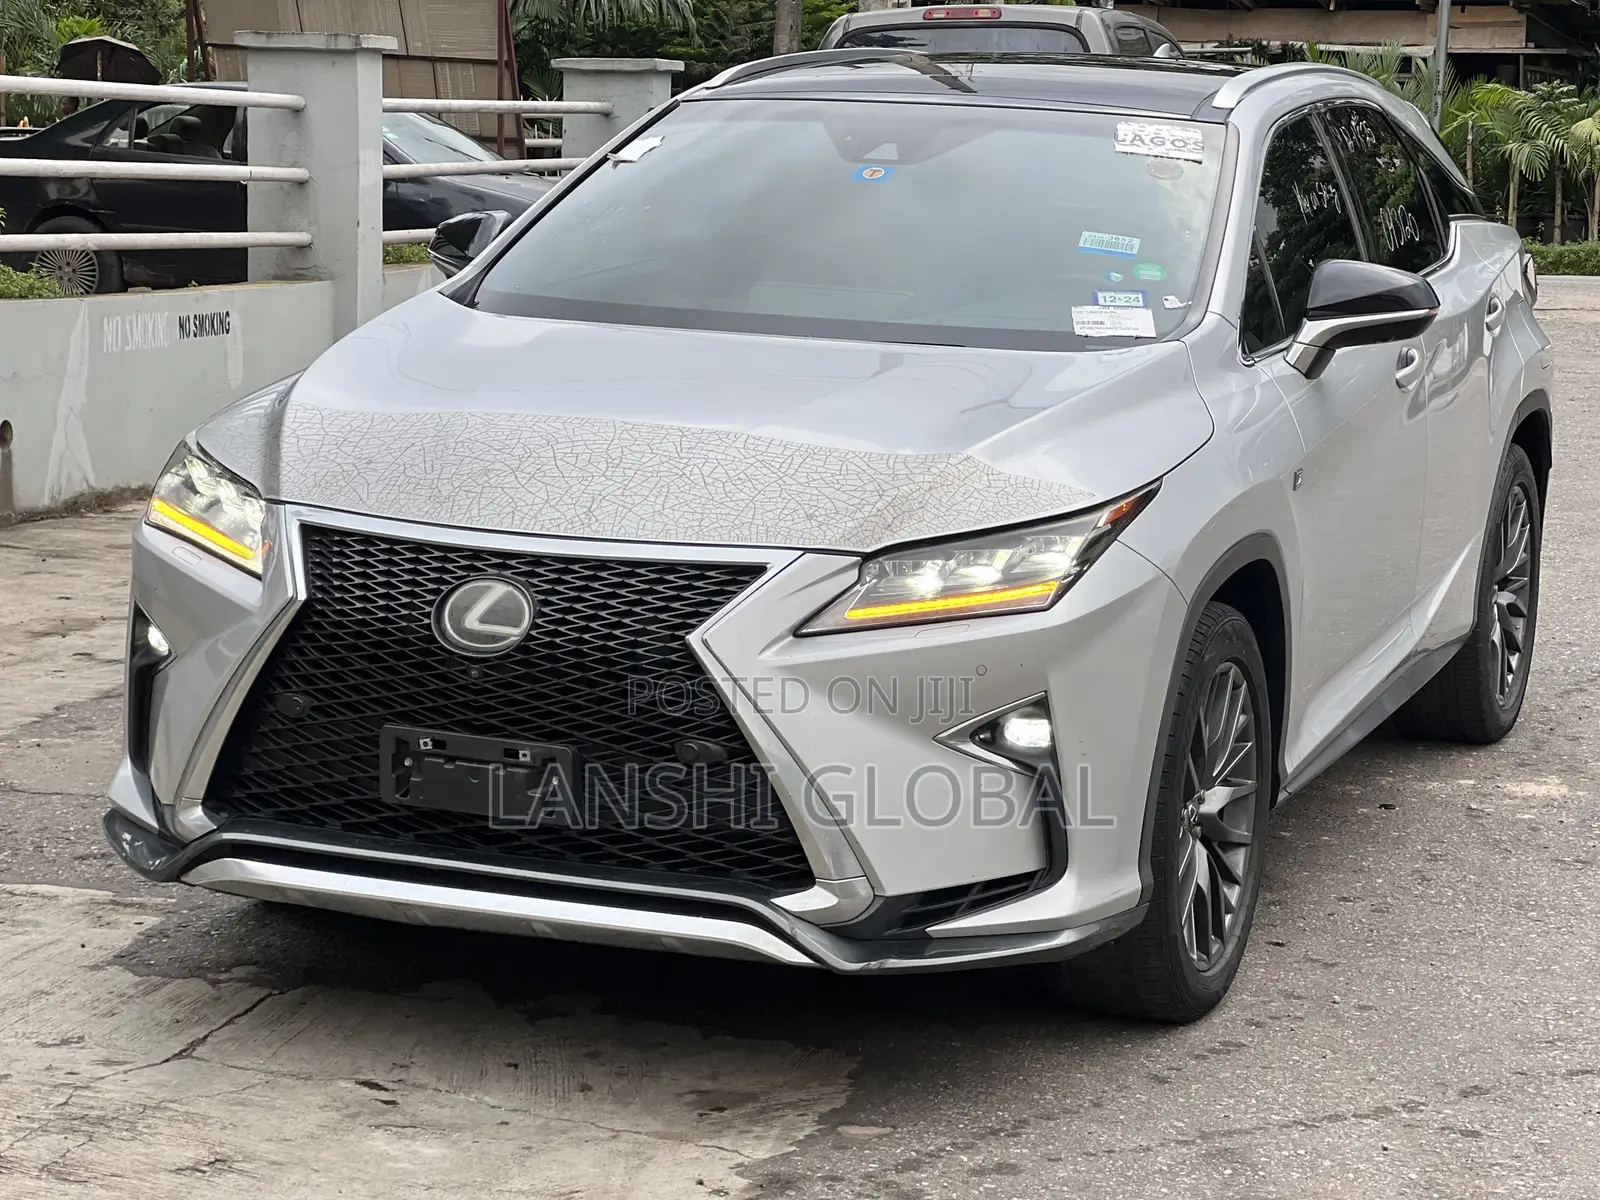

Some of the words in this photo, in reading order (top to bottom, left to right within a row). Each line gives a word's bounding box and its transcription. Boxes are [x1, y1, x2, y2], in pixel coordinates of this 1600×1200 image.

[103, 315, 121, 353] NO
[178, 314, 191, 339] NO
[193, 310, 230, 338] SMOKING
